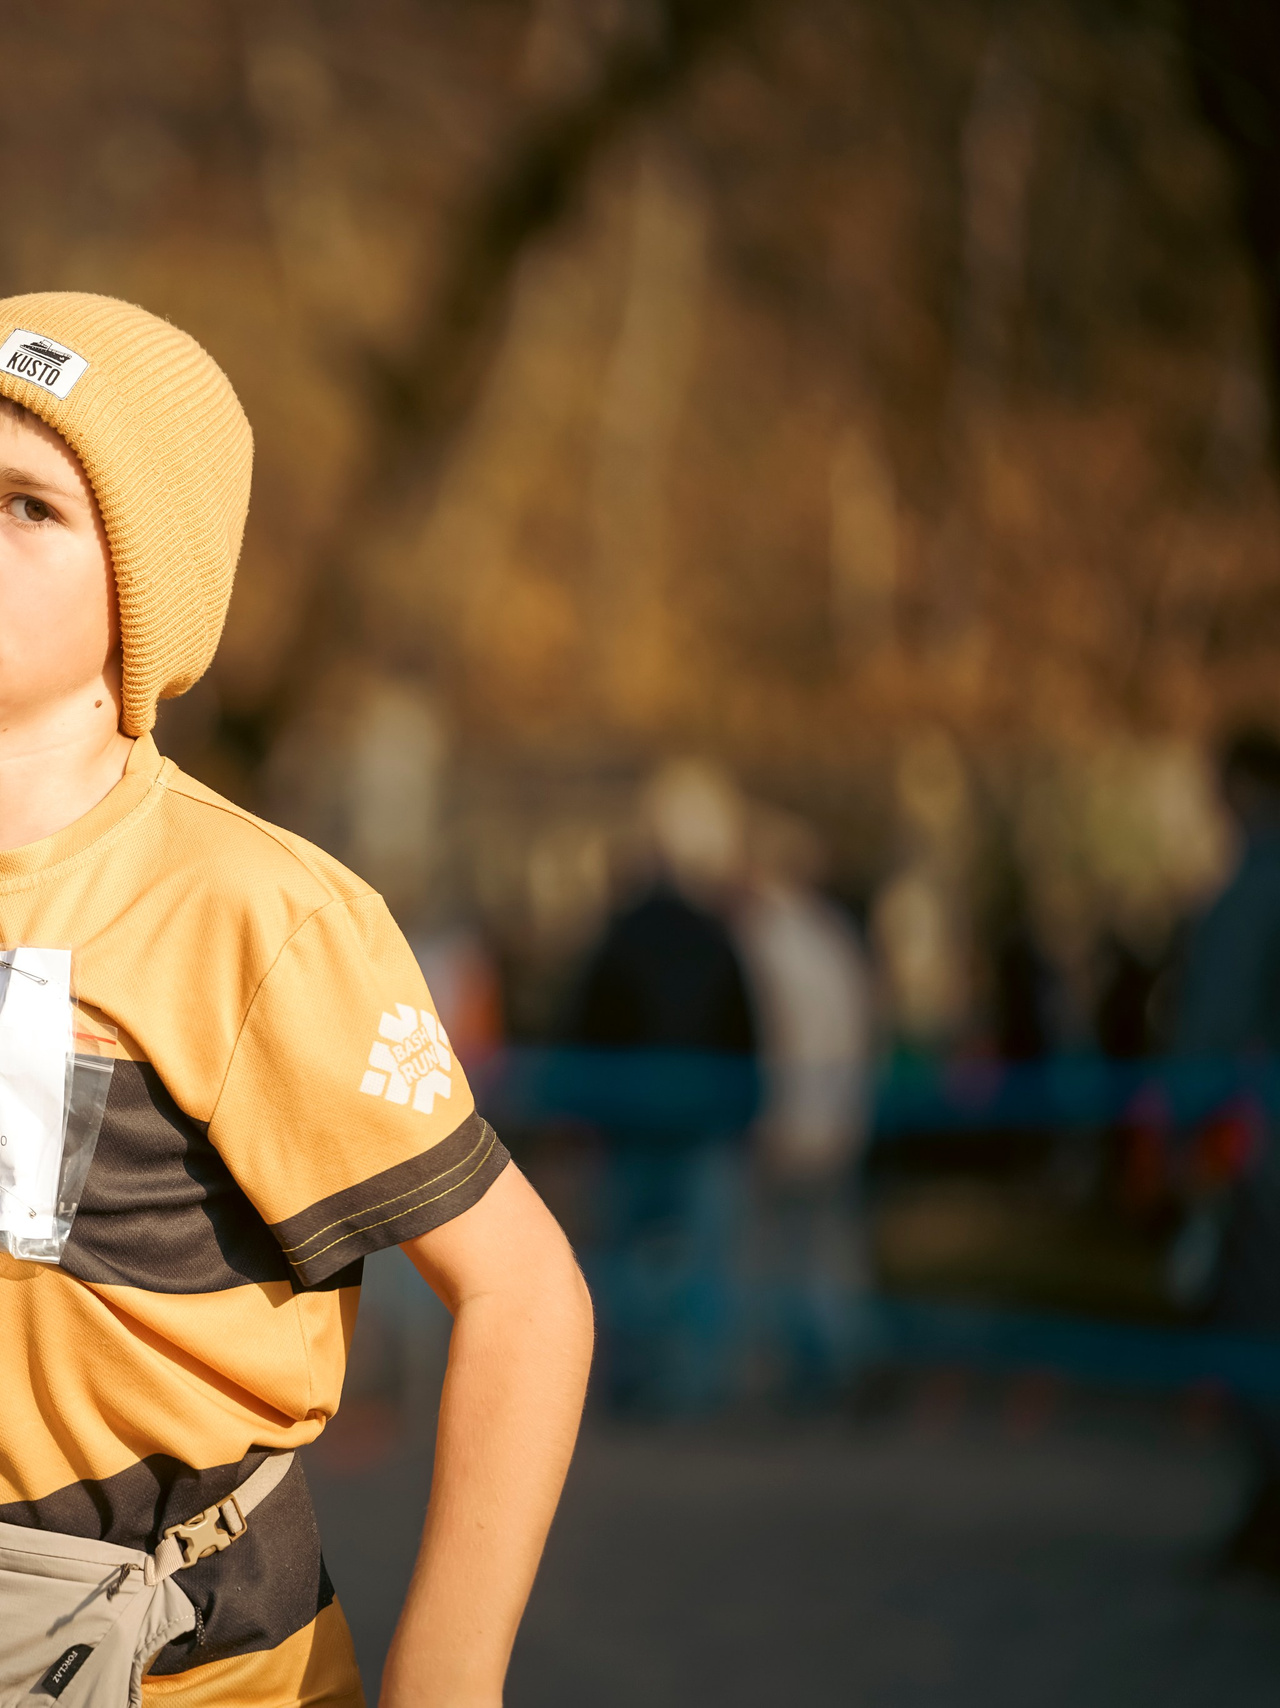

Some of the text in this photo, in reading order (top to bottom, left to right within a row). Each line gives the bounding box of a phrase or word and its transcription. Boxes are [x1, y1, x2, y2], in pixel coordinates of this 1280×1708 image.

[6, 351, 61, 387] KUSTO
[392, 1025, 430, 1062] BASH
[400, 1045, 440, 1084] RUN
[53, 1650, 78, 1683] FORCLAZ
